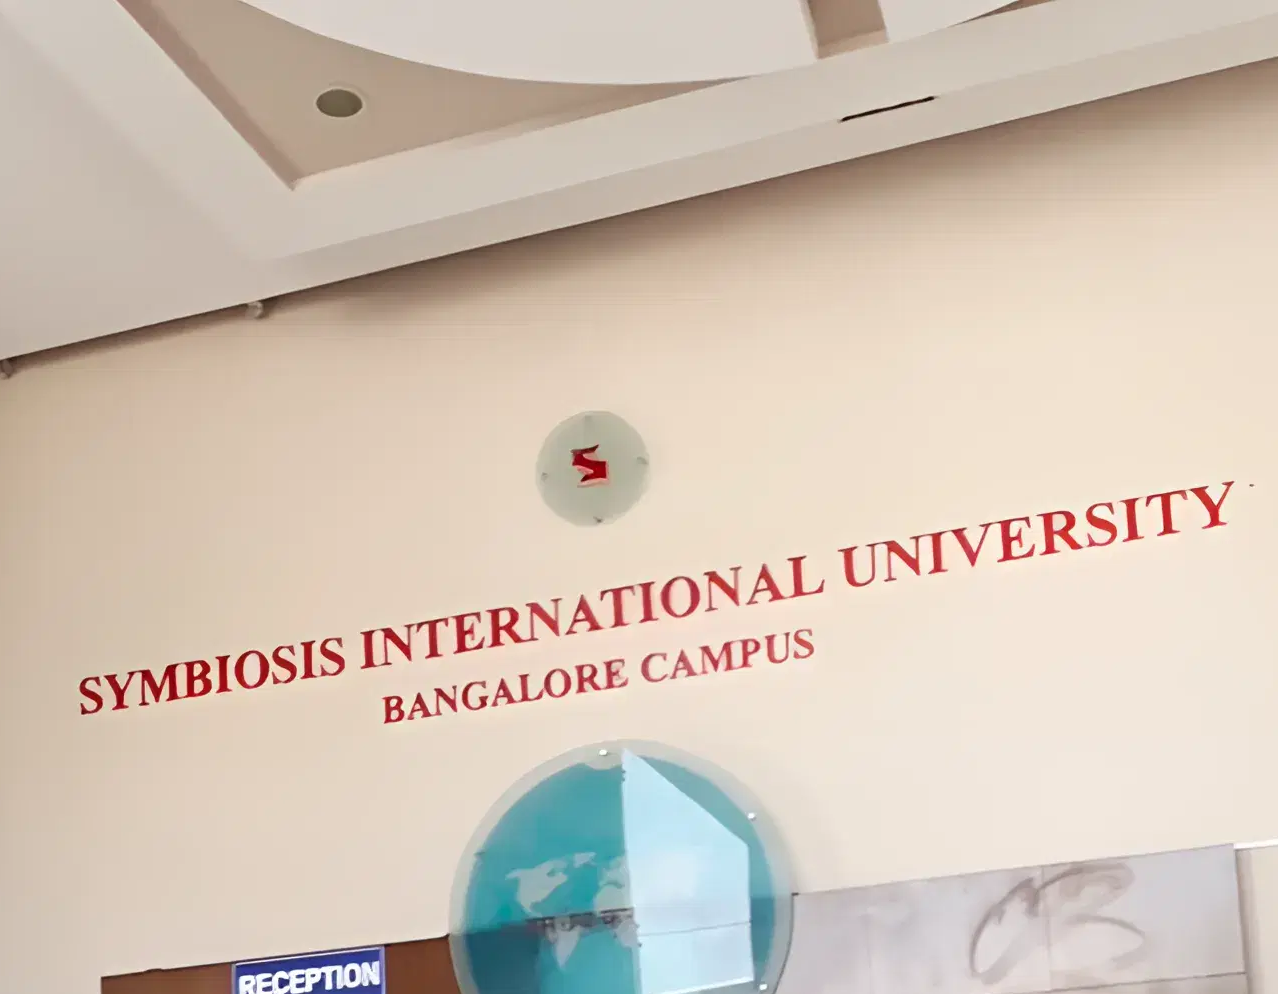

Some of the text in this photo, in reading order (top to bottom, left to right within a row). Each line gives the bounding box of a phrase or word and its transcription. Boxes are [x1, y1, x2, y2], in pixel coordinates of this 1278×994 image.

[77, 481, 1236, 716] SYMBIOSIS INTERNATIONAL UNIVERSITY
[382, 629, 815, 724] BANGALORE CAMPUS
